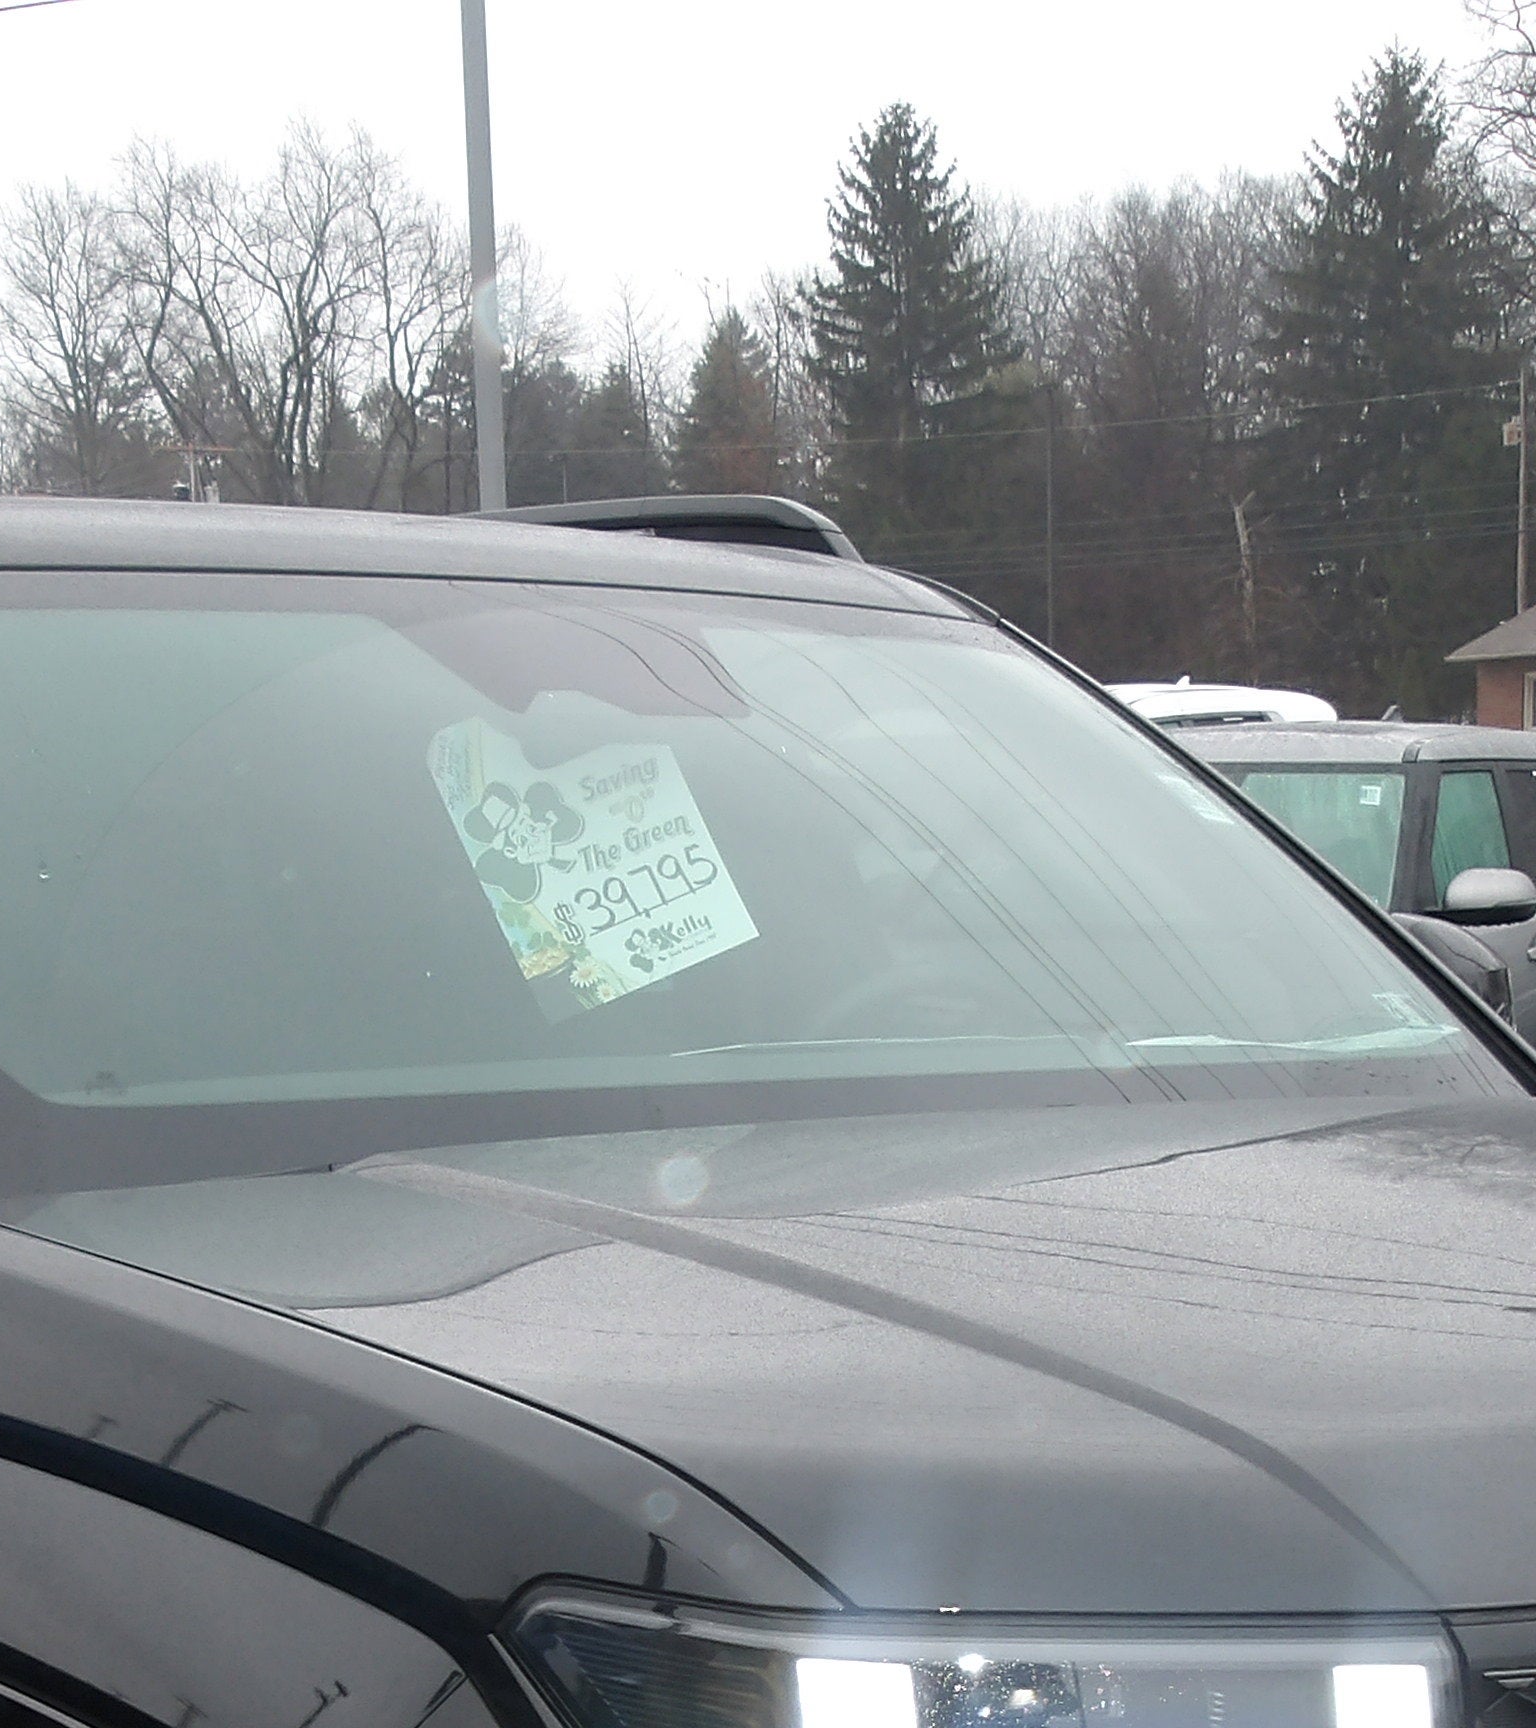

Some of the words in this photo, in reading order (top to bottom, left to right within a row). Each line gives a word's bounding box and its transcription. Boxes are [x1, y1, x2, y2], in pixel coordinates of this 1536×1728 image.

[579, 757, 659, 802] Saving
[578, 843, 622, 873] The
[623, 815, 696, 854] Green
[658, 914, 713, 945] Kelly
